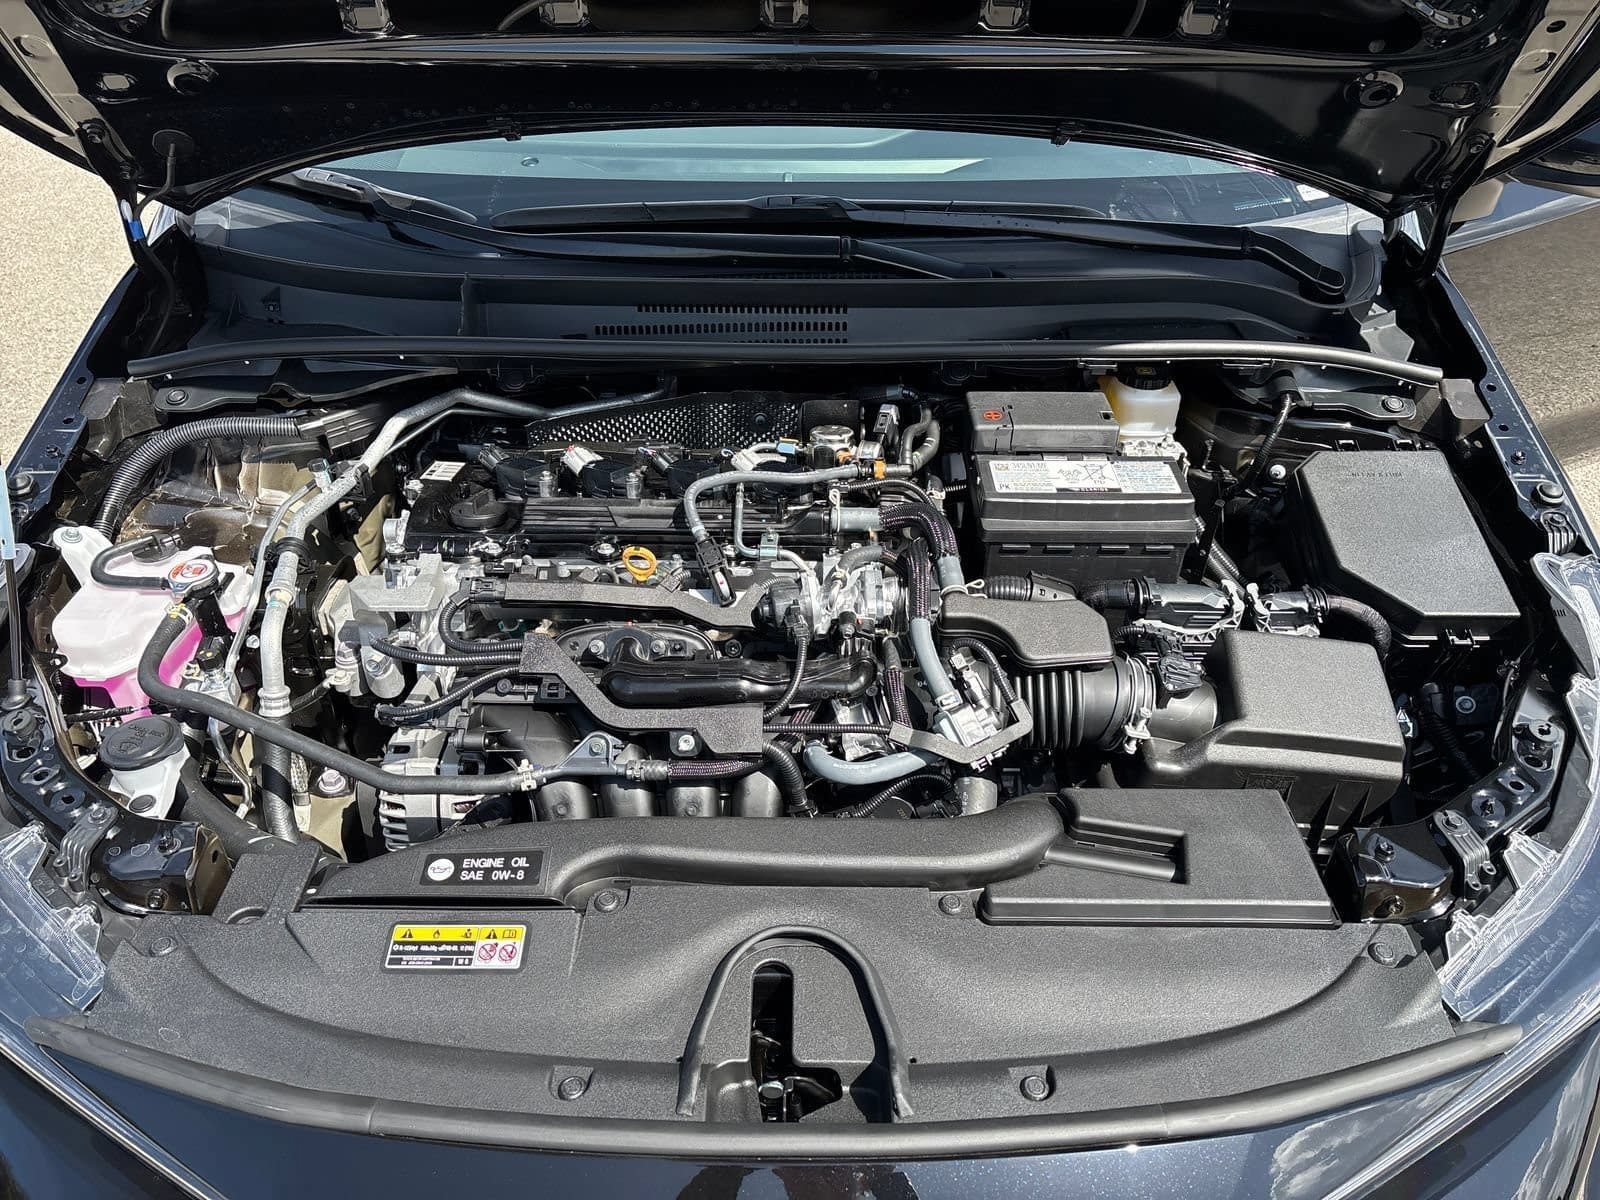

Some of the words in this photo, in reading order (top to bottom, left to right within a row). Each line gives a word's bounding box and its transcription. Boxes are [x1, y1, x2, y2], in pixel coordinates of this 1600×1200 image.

[462, 857, 505, 869] ENGINE
[511, 856, 530, 868] OIL
[460, 870, 485, 881] SAE
[491, 869, 525, 881] 0W-8
